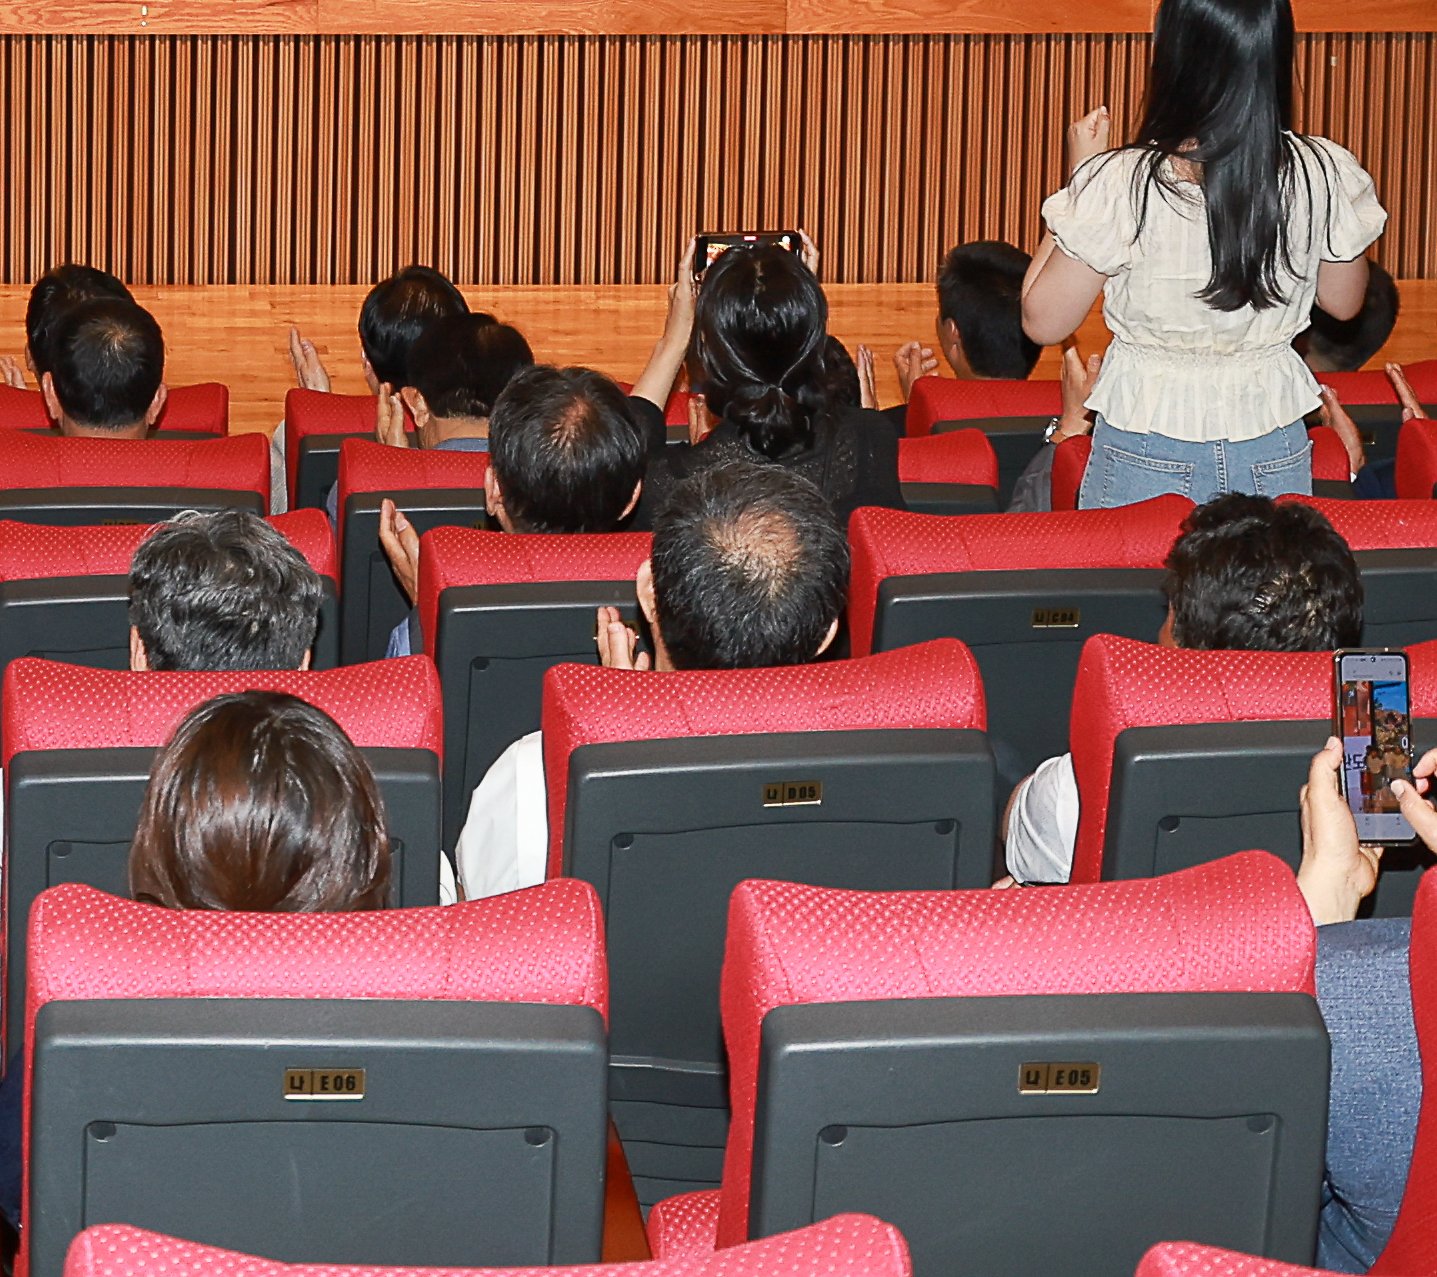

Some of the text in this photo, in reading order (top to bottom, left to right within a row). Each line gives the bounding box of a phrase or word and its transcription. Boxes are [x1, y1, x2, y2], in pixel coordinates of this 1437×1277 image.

[767, 789, 777, 800] 나
[290, 1076, 356, 1091] 나 E06
[1025, 1069, 1091, 1085] 나 E05
